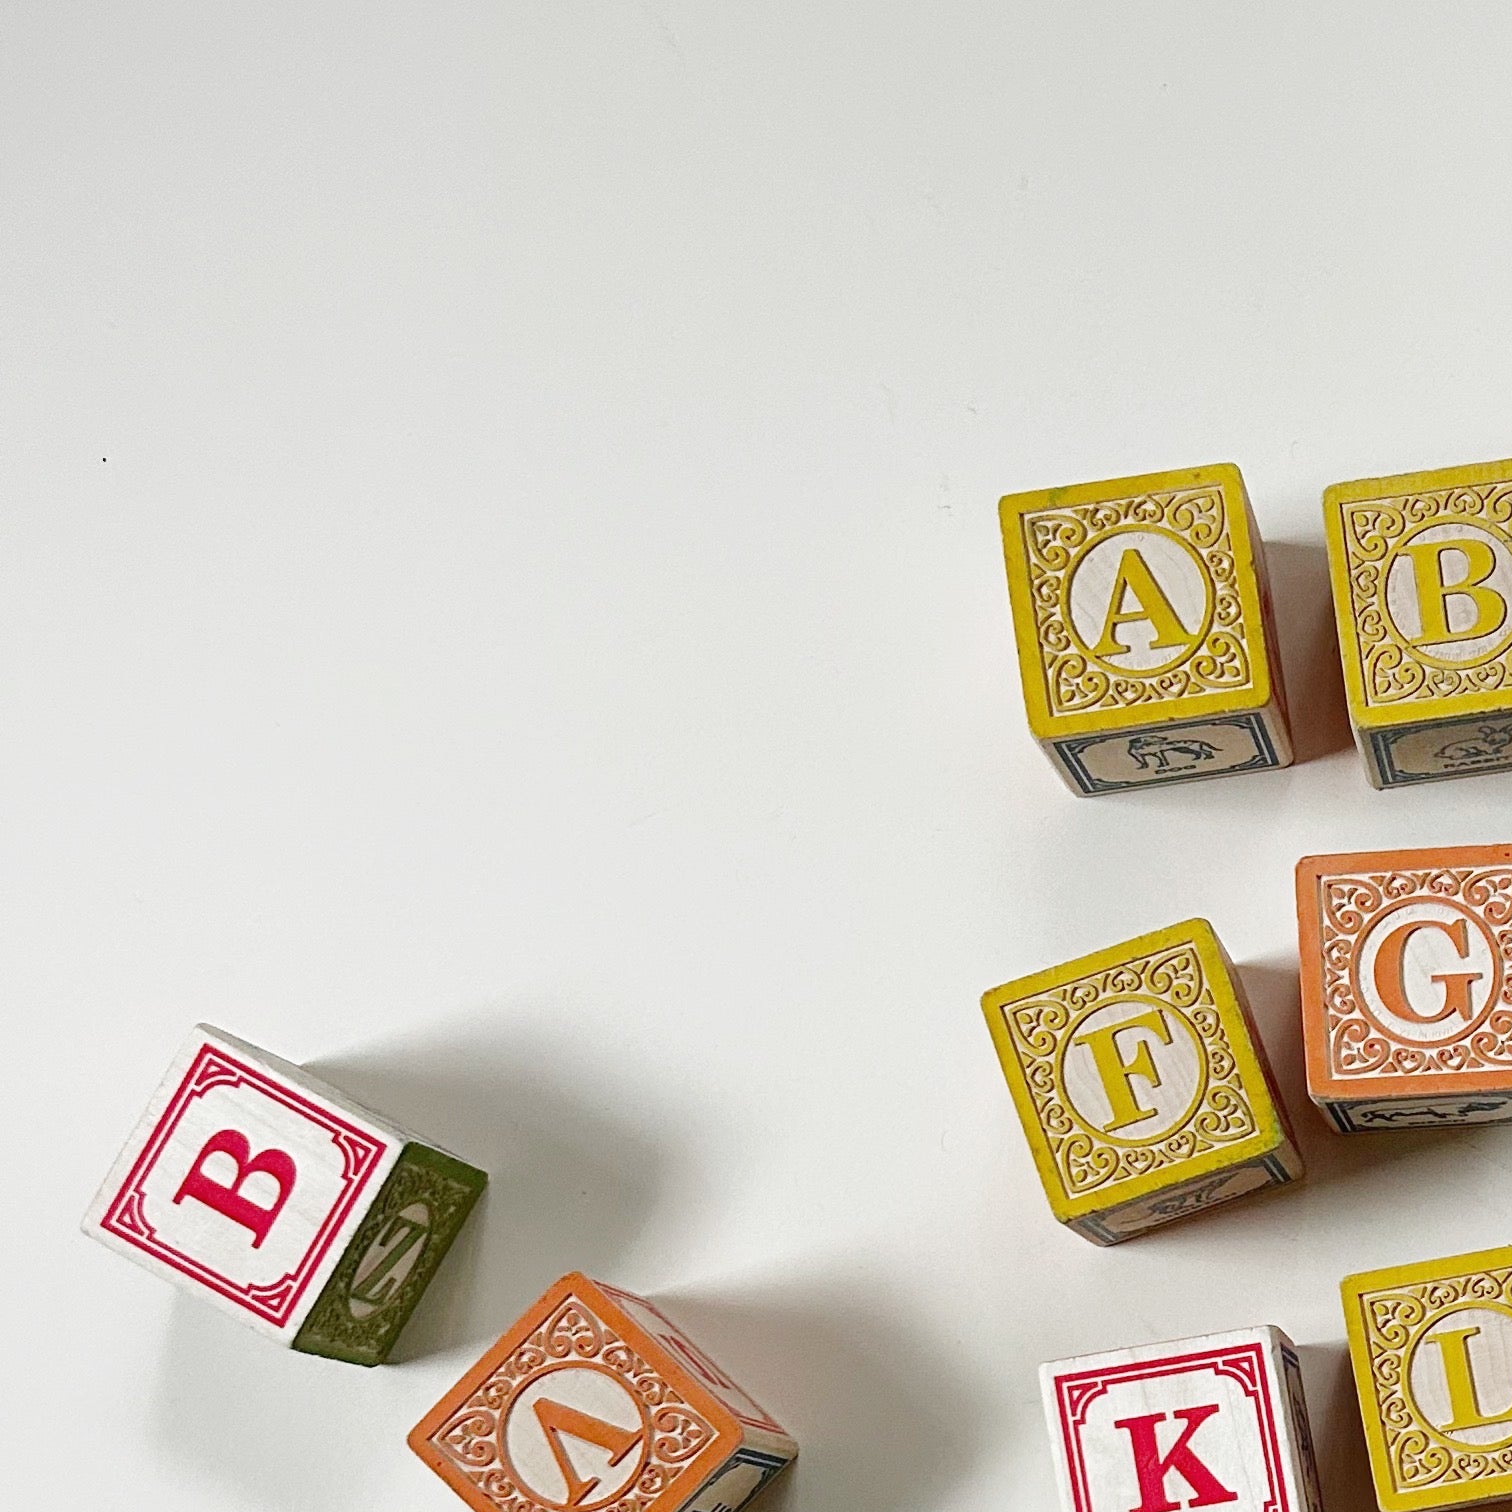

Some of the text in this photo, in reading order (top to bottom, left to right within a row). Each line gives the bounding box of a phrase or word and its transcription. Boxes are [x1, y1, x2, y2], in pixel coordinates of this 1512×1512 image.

[1091, 549, 1199, 657] A
[1397, 539, 1507, 648] B
[1374, 918, 1483, 1024] G
[1074, 1009, 1173, 1133] F
[172, 1128, 297, 1249] B
[533, 1397, 646, 1507] V
